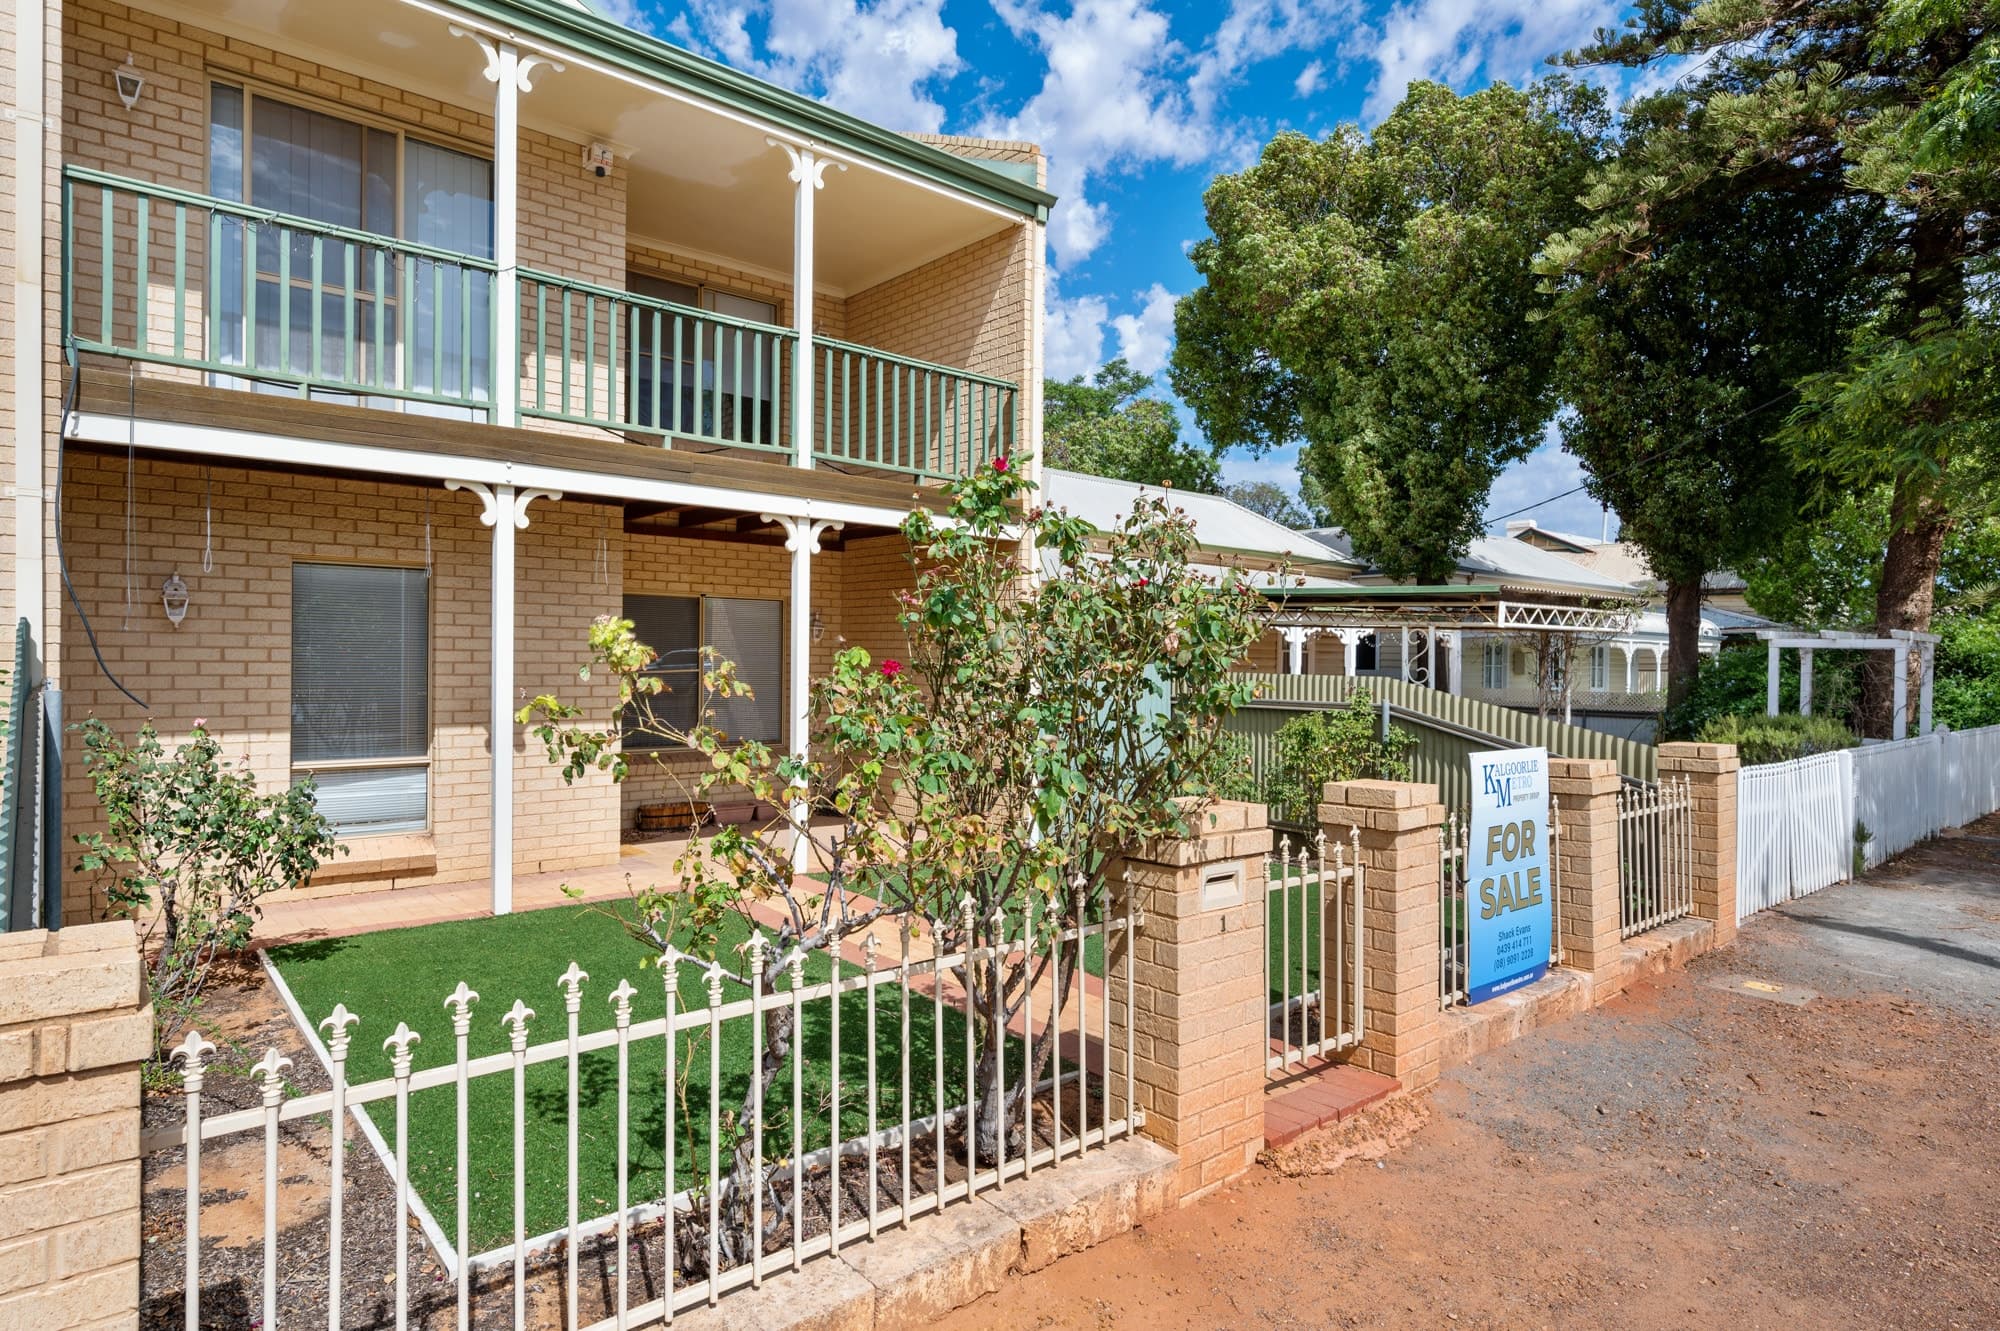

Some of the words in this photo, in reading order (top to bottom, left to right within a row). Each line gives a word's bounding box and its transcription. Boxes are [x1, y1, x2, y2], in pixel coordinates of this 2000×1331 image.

[1482, 760, 1539, 795] KALGOORLIE
[1496, 775, 1533, 808] METRO
[1486, 819, 1536, 866] FOR
[1480, 866, 1543, 920] SALE
[1498, 927, 1515, 942] Shack
[1515, 924, 1531, 936] Evans
[1522, 935, 1532, 947] 711
